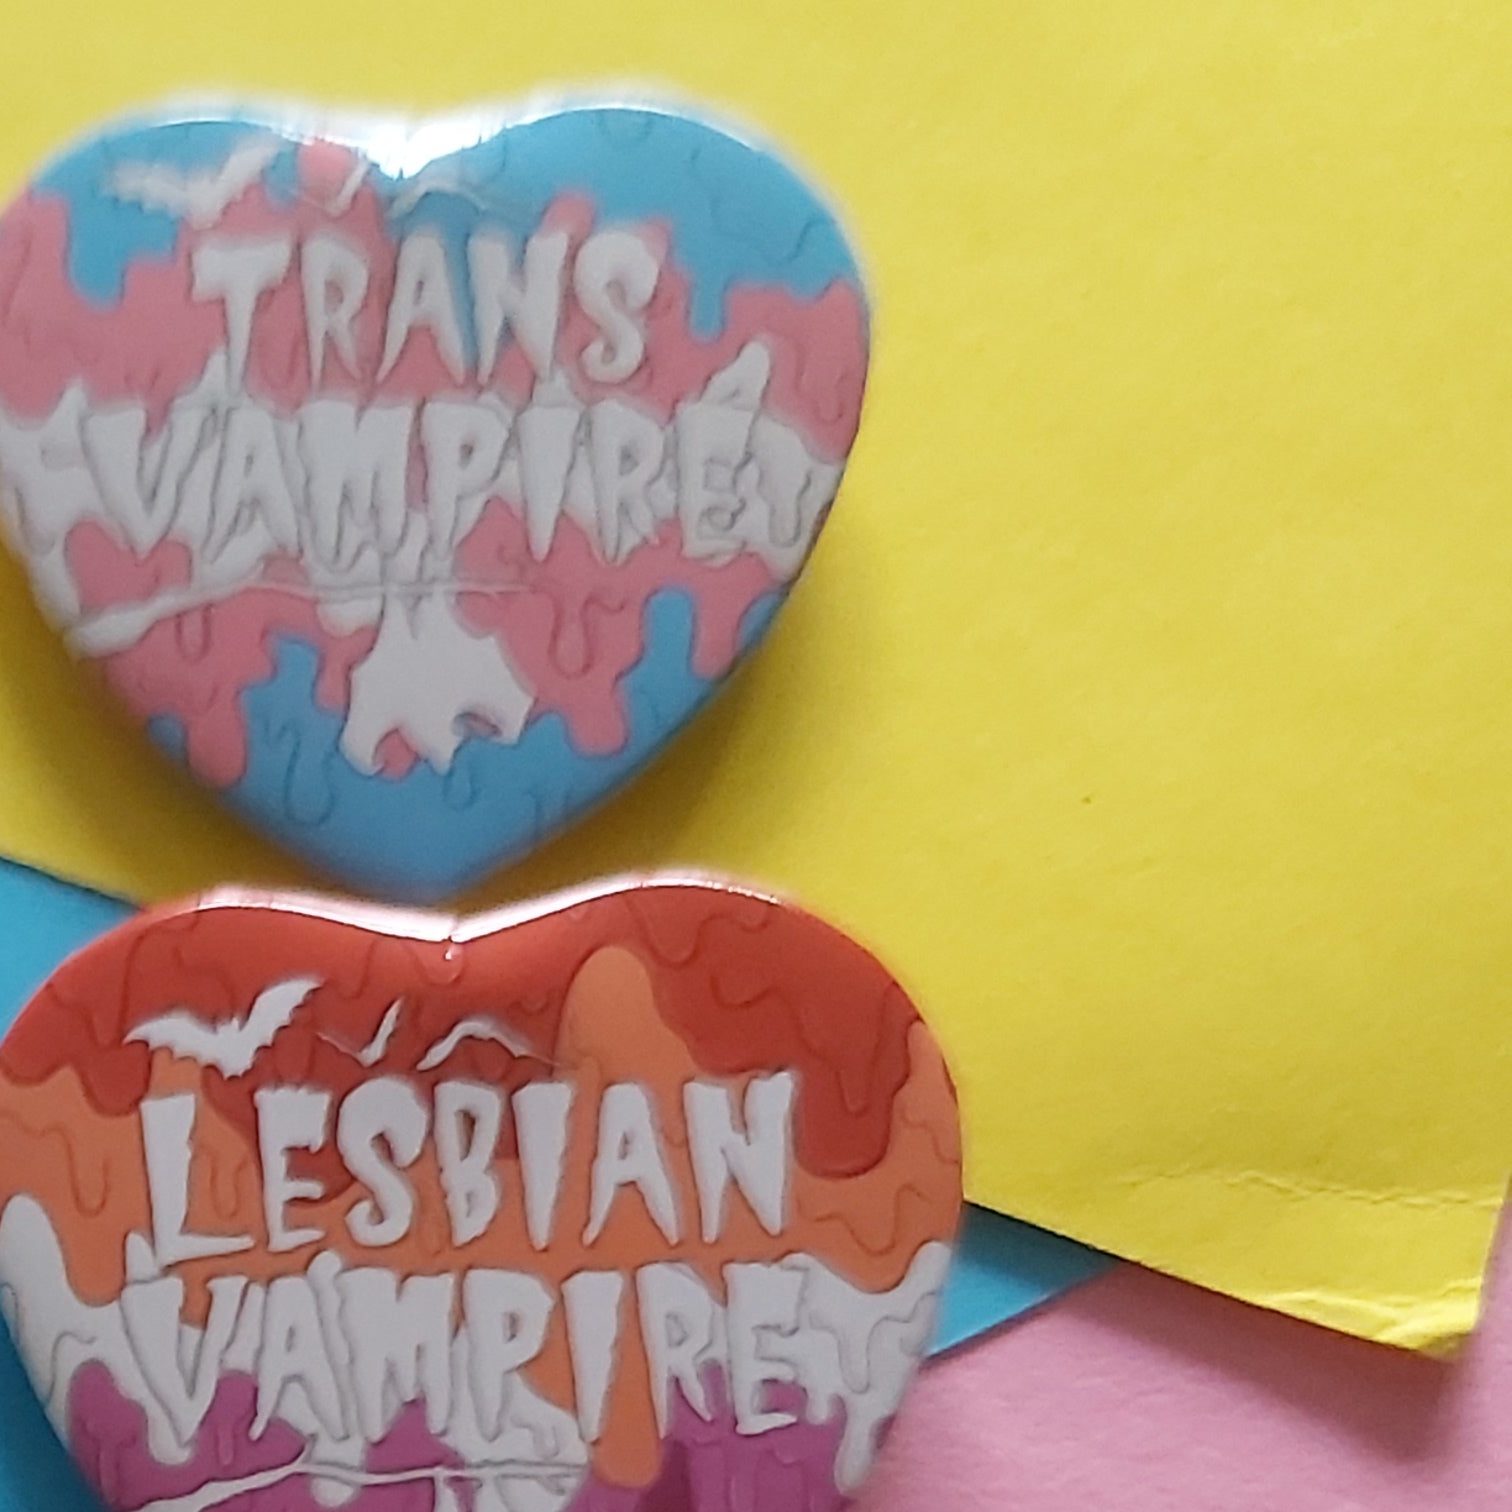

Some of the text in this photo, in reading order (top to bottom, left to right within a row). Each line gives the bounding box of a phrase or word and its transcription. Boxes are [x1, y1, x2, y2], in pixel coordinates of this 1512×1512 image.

[192, 226, 661, 396] TRANS
[89, 396, 768, 566] VAMPIRE
[140, 1070, 796, 1267] LESBIAN
[122, 1257, 810, 1446] VAMPIRE
